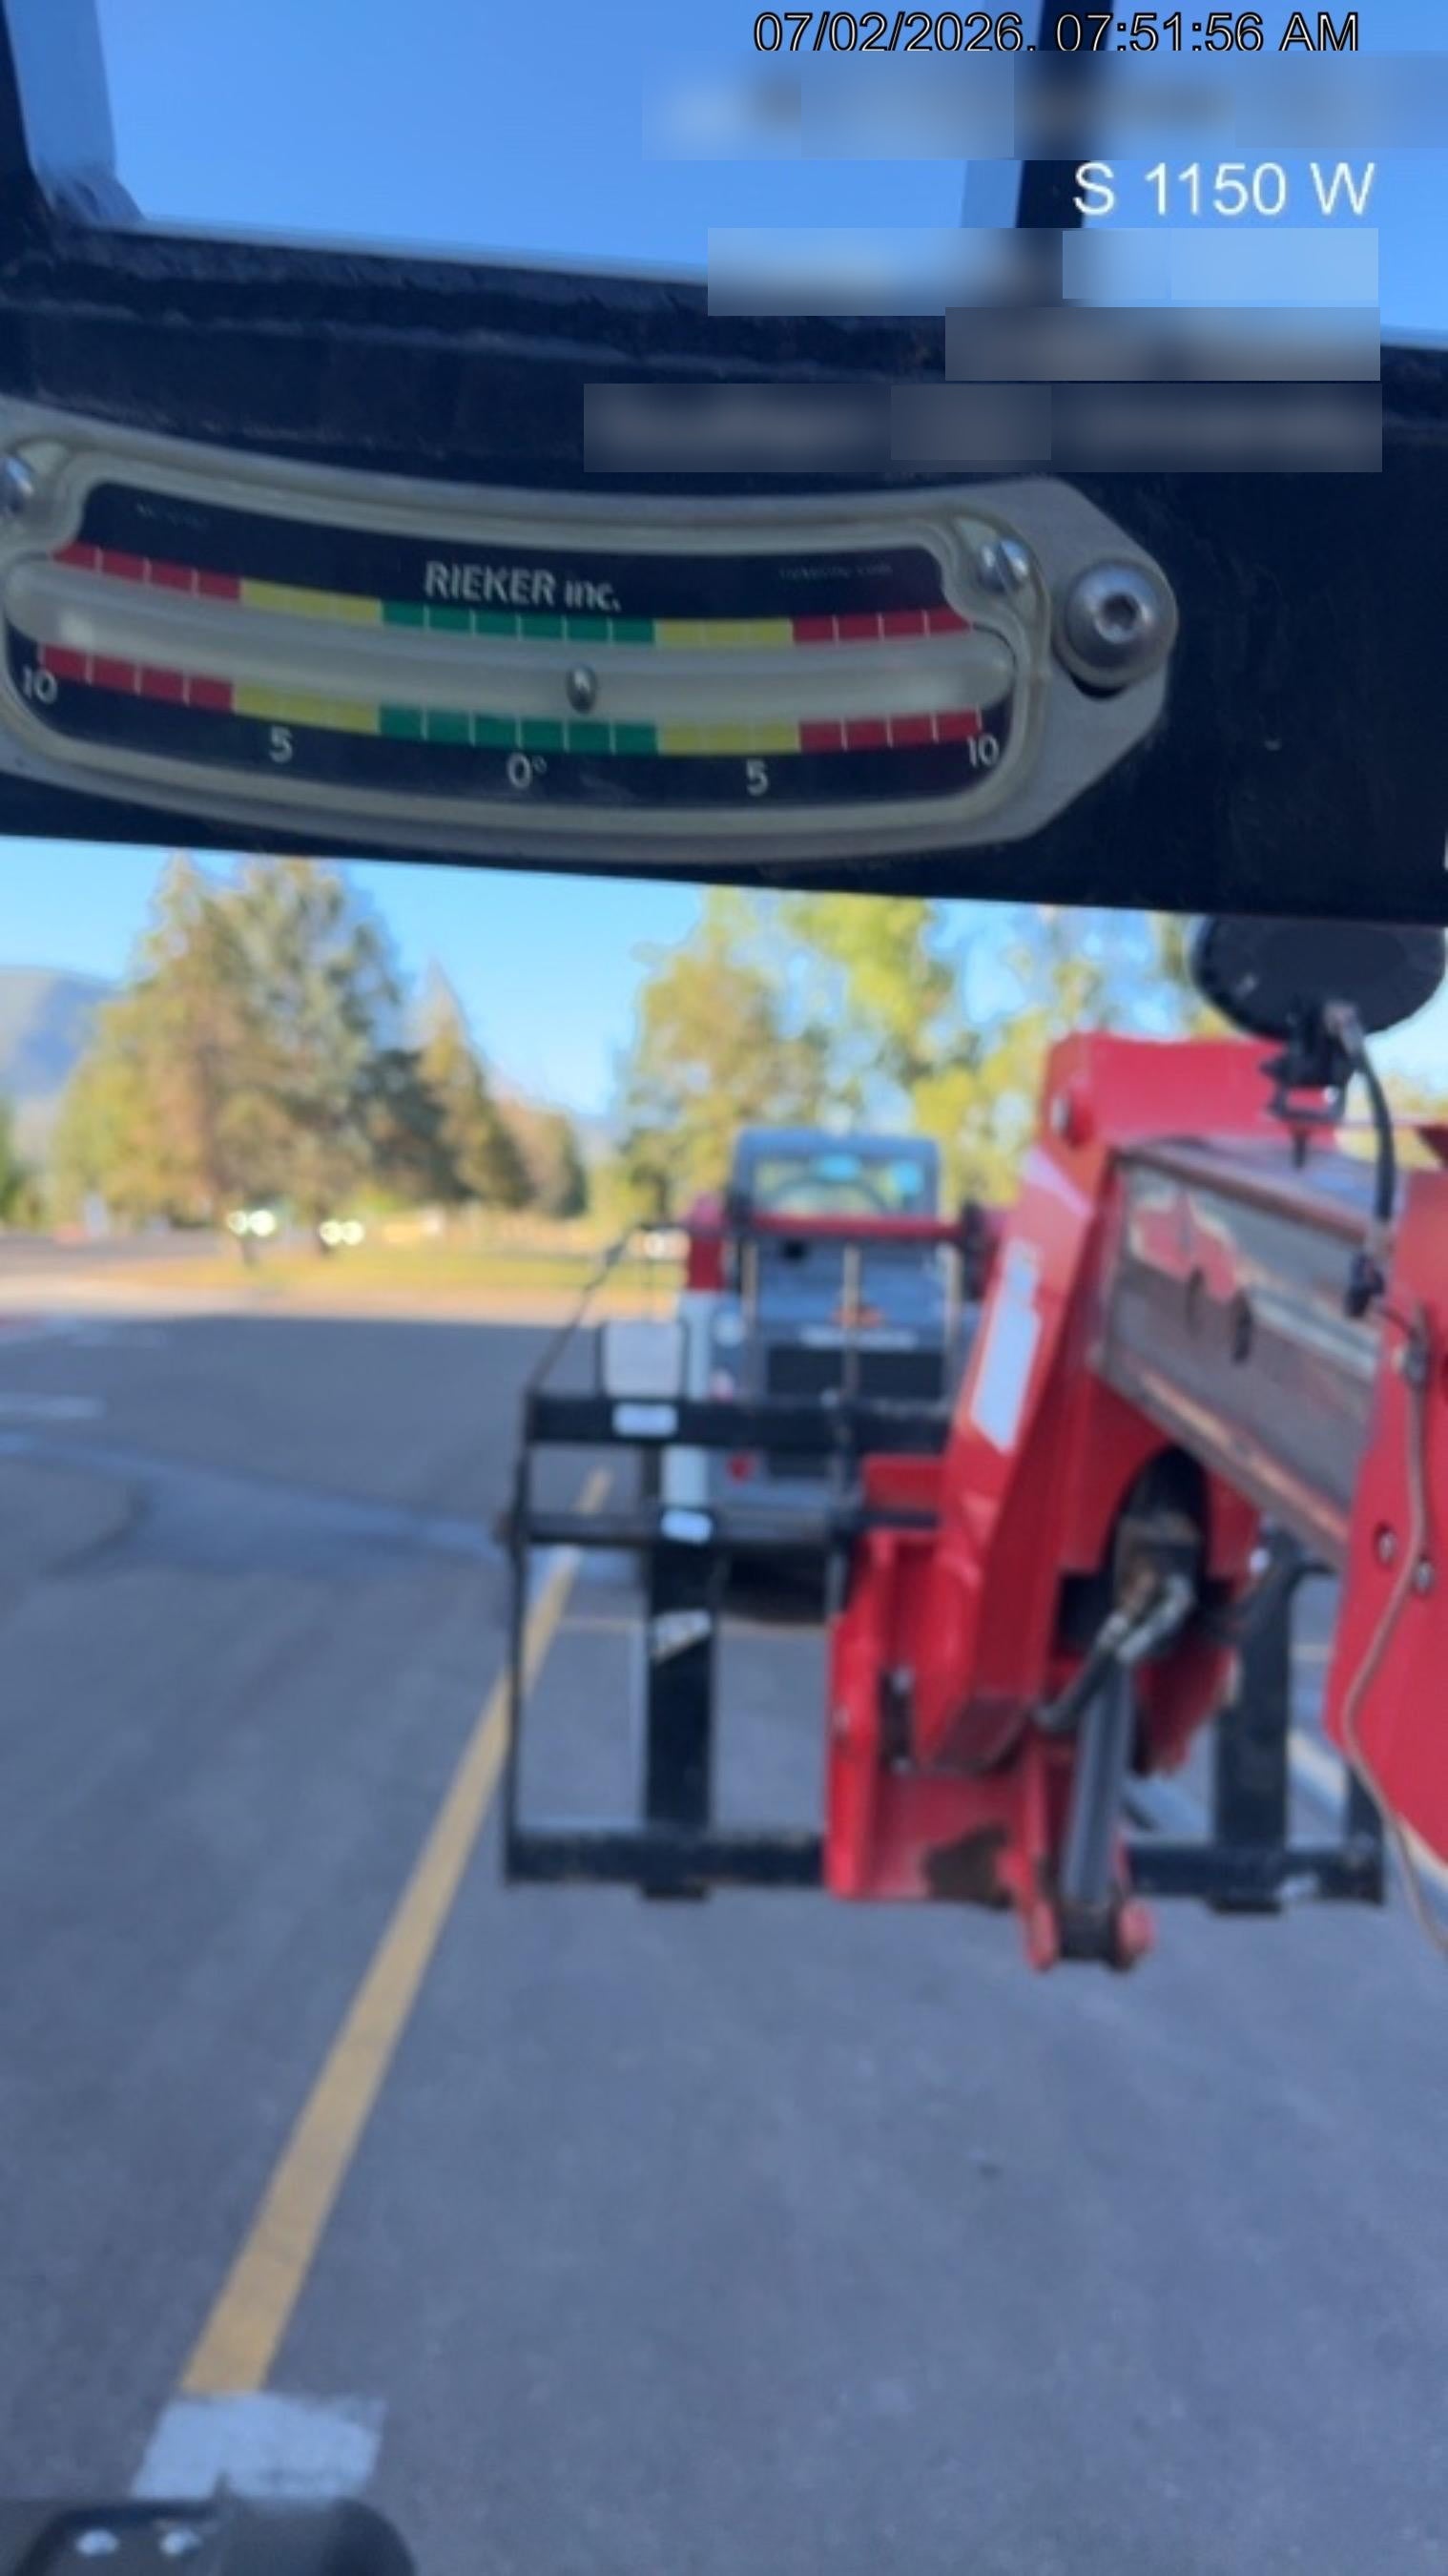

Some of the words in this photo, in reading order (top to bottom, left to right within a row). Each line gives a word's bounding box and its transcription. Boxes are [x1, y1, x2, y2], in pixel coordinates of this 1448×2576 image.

[424, 559, 557, 608] RIEKER
[22, 666, 58, 705] 10
[268, 726, 294, 762] 5
[745, 759, 769, 796] 5
[966, 734, 1001, 768] 10
